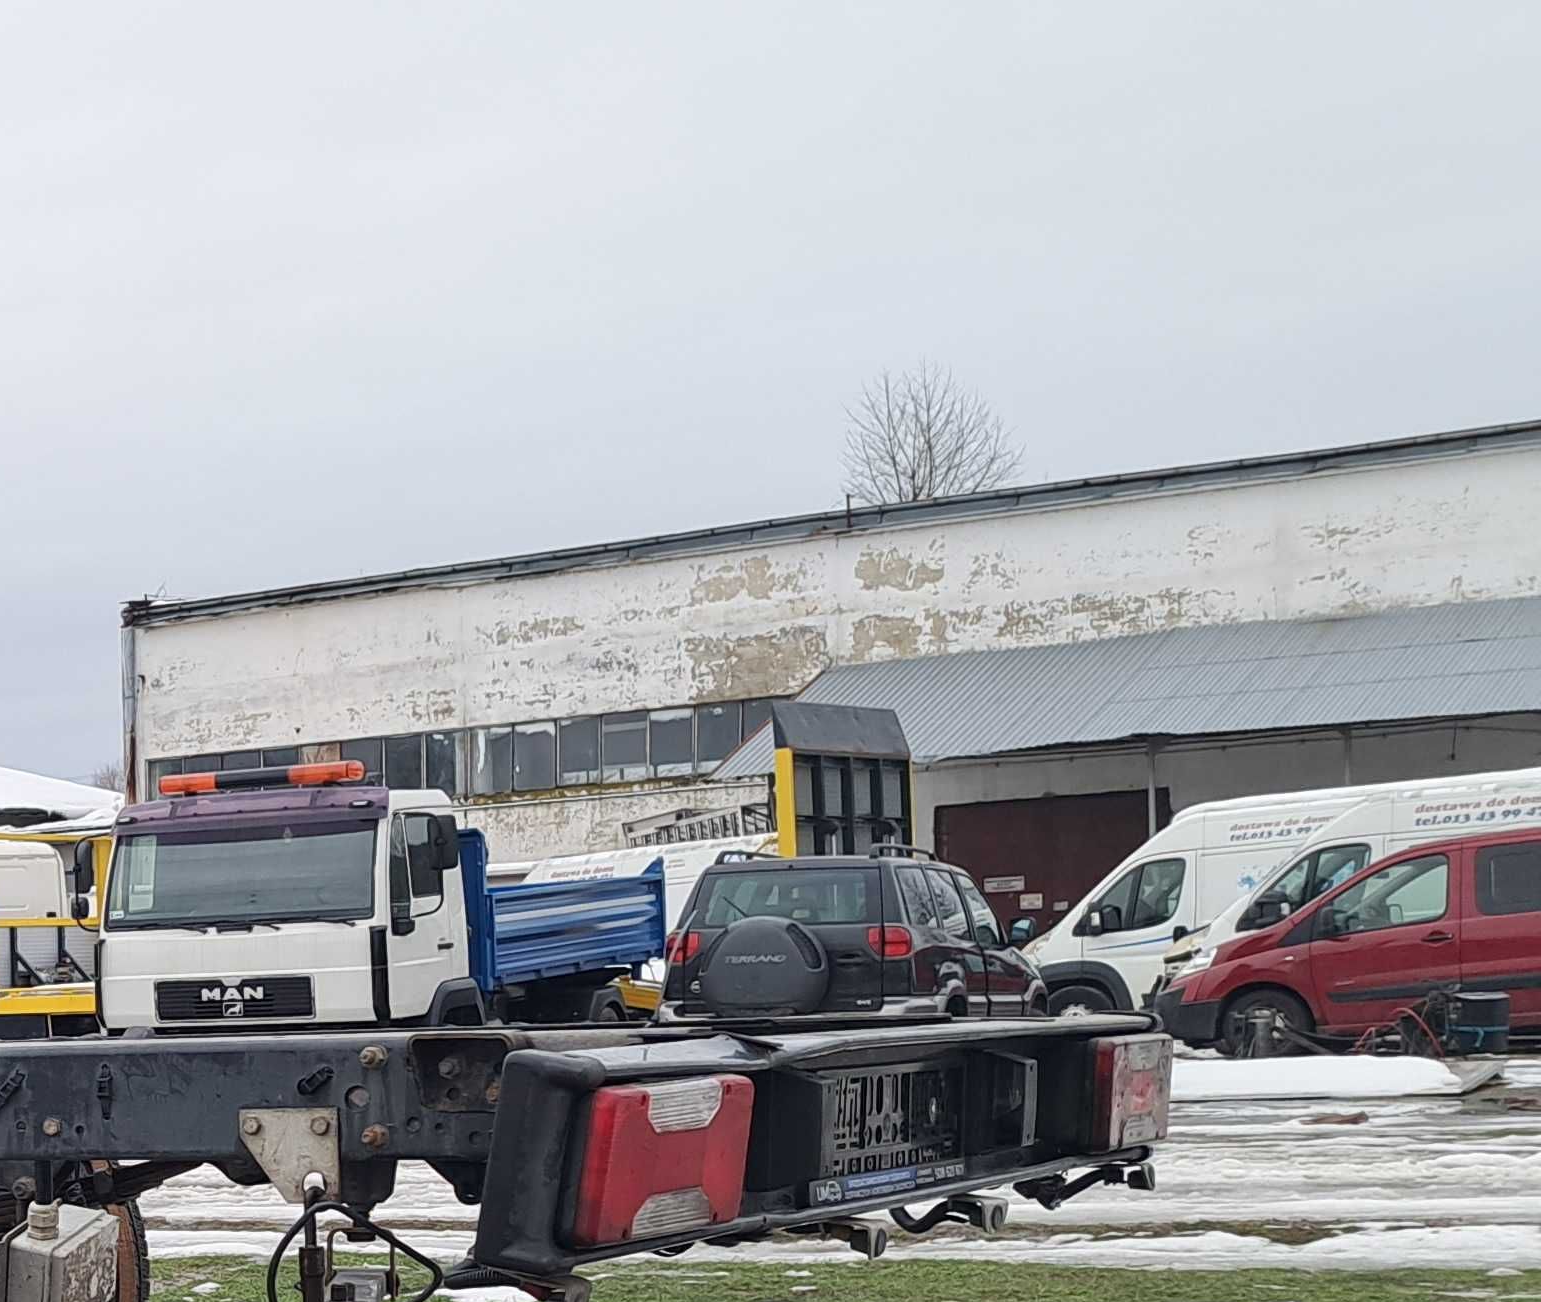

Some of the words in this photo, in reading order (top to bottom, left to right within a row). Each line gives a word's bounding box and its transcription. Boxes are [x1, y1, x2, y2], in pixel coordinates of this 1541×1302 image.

[1414, 802, 1482, 814] dostawa
[1486, 798, 1506, 808] do
[1230, 821, 1281, 831] dostawa
[1284, 818, 1299, 826] do
[1414, 813, 1471, 827] tel.013
[1475, 810, 1496, 822] 43
[1501, 809, 1522, 820] 99
[724, 954, 787, 965] TERRANO
[201, 986, 264, 1001] MAN
